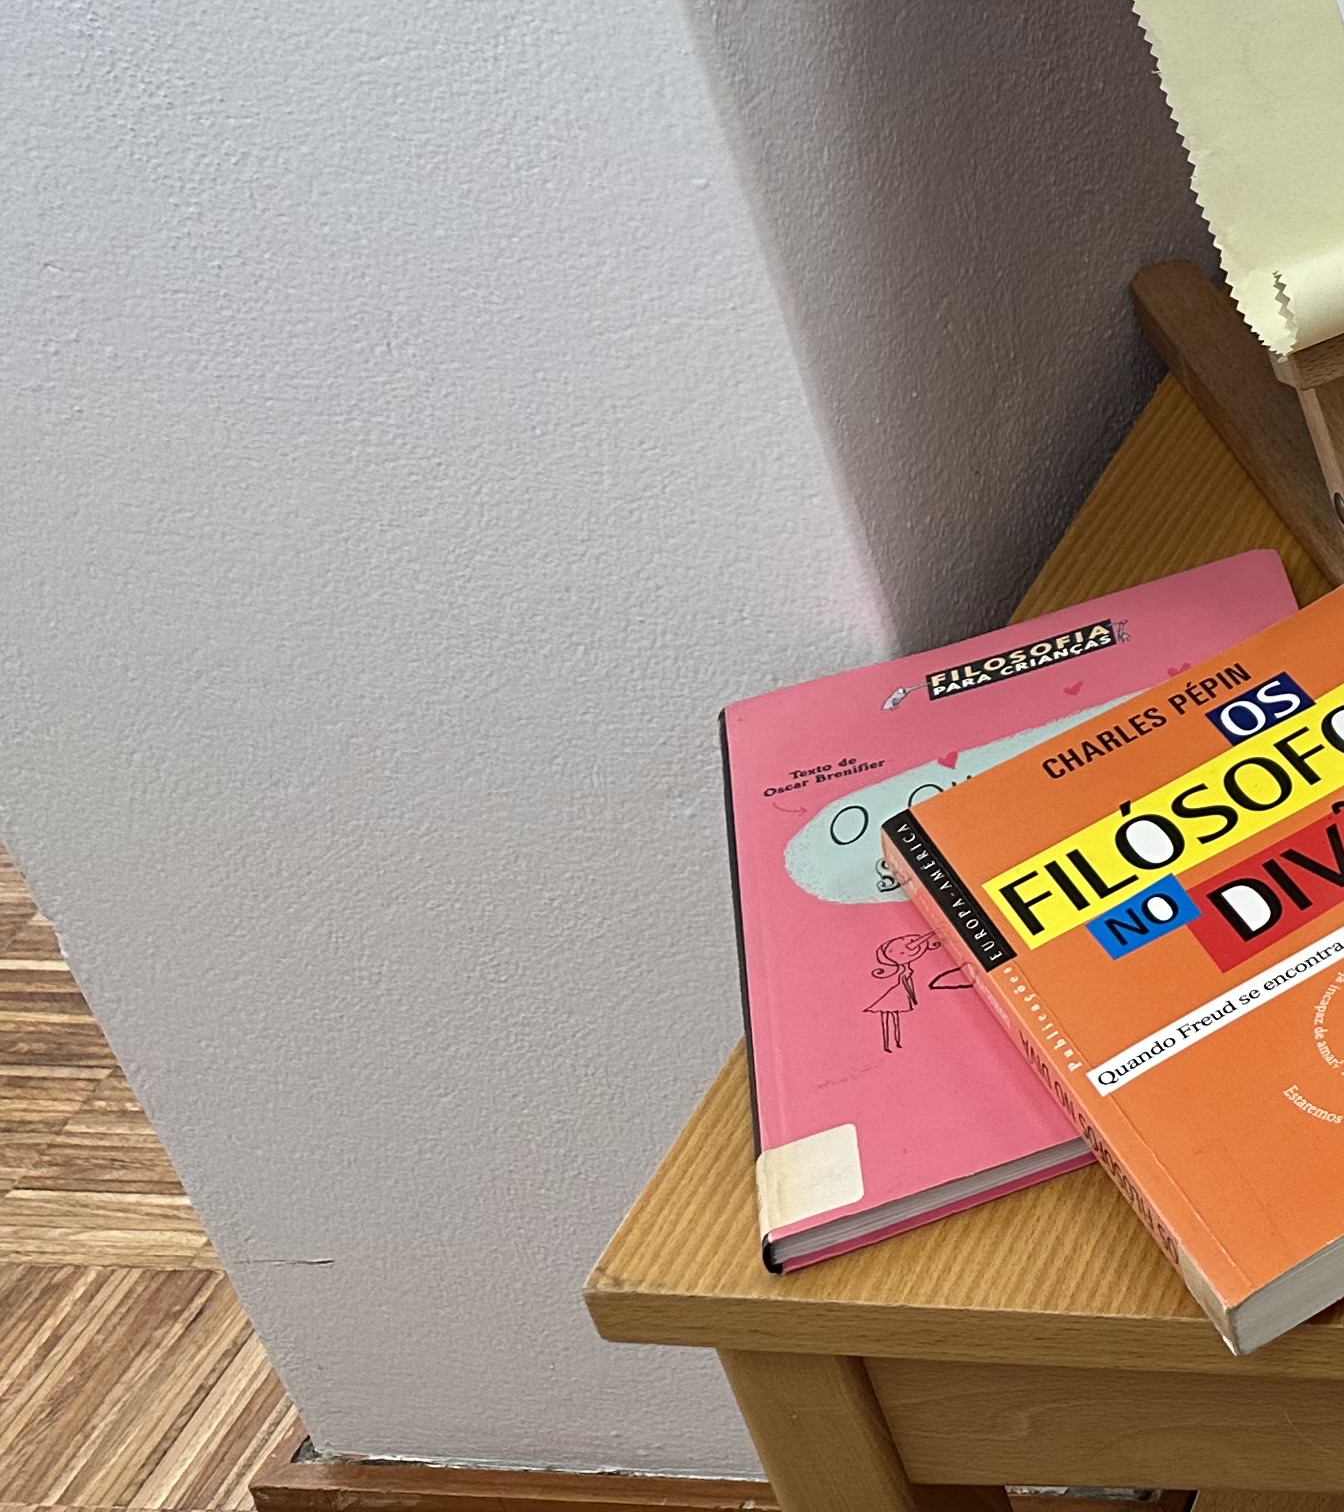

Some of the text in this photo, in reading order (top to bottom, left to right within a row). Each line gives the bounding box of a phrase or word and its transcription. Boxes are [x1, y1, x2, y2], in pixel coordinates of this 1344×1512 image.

[930, 623, 1110, 687] FILOSOFIA
[932, 634, 1113, 697] PARA CRIANÇAS
[1042, 662, 1252, 780] CHARLES PÉPIN
[1220, 680, 1302, 738] OS
[763, 758, 886, 798] Oscar Brenifier
[789, 756, 857, 780] Texto de
[830, 804, 869, 846] O
[896, 822, 1003, 962] EUROPA-AMÉRICA
[1105, 892, 1180, 947] NO
[1004, 966, 1082, 1072] Publicações
[1098, 1037, 1176, 1085] Quando
[1176, 1000, 1237, 1039] Freud
[1239, 989, 1260, 1005] se
[1264, 942, 1344, 991] encontra
[1283, 1084, 1343, 1125] Estaremos
